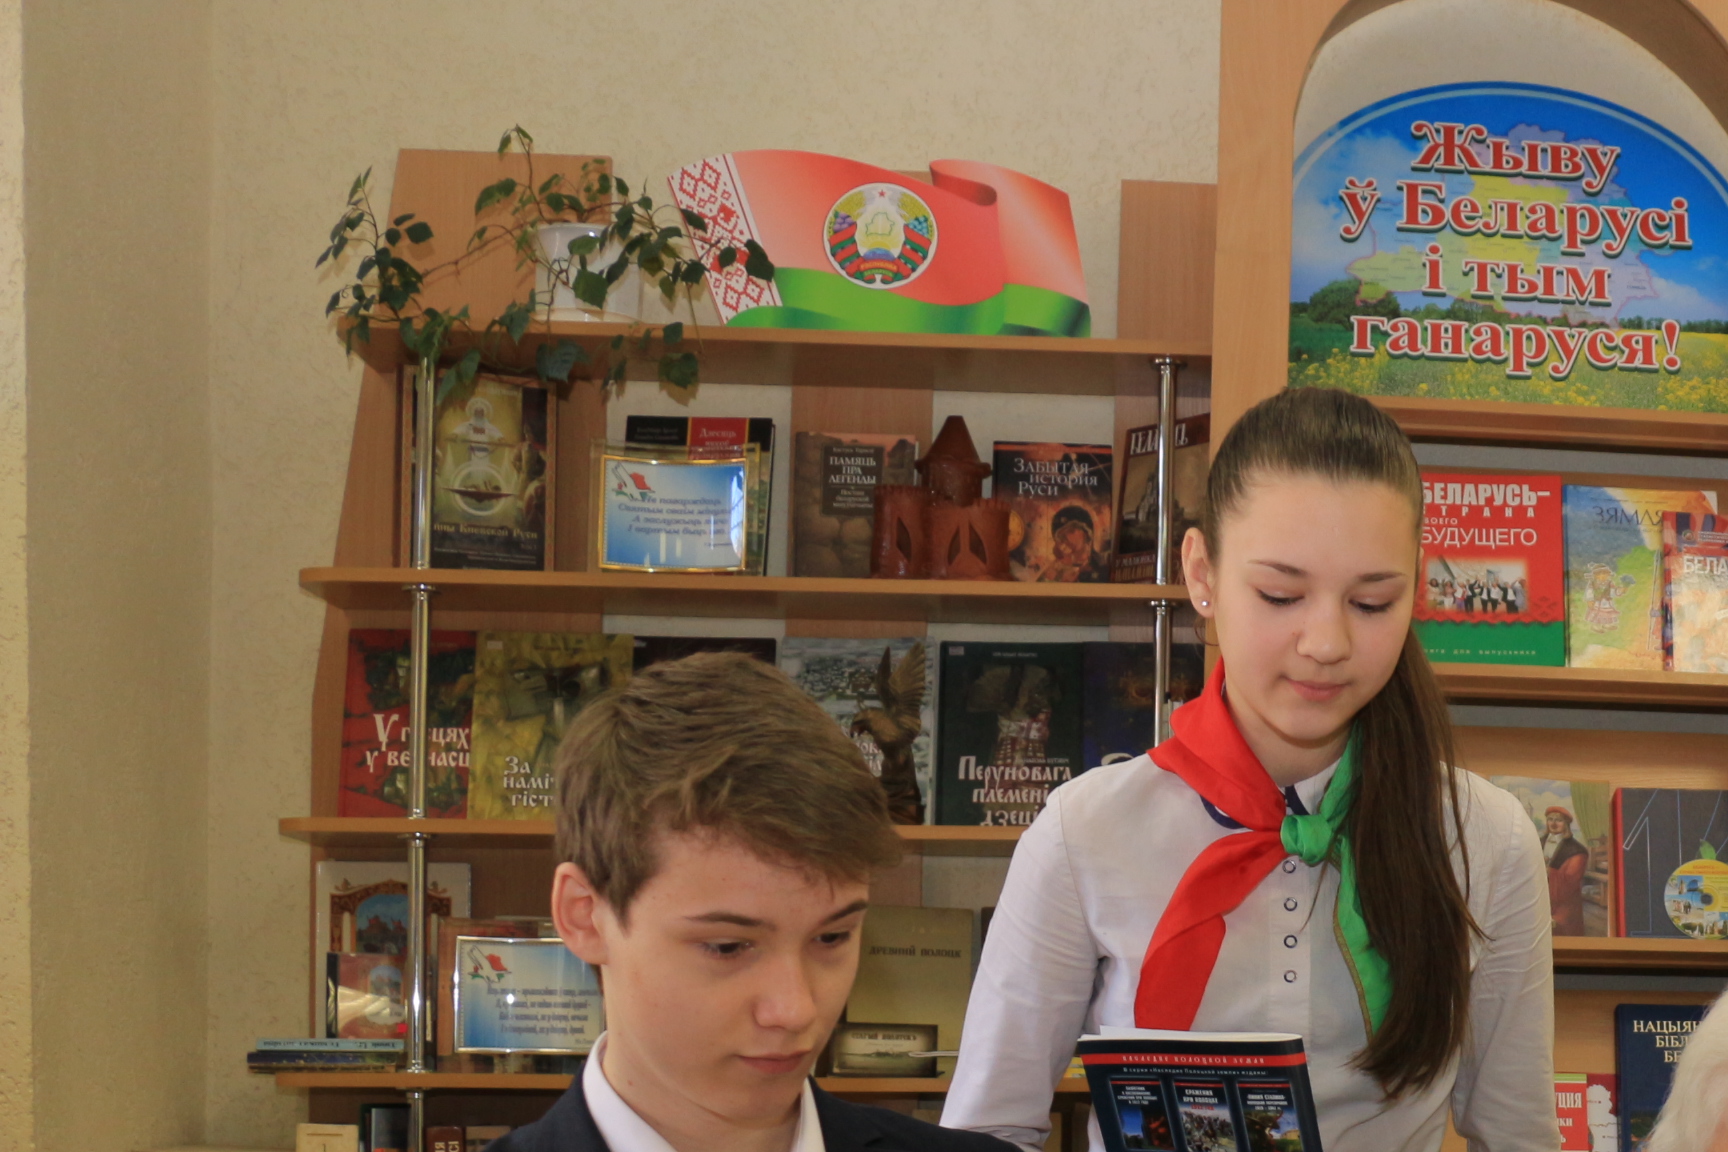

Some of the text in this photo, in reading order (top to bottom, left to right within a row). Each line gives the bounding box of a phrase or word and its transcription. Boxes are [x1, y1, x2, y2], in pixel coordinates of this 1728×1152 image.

[1410, 121, 1620, 194] Жыву
[1339, 177, 1692, 257] ў Беларусі
[1422, 243, 1612, 306] і тым
[1350, 314, 1681, 379] ганаруся!
[1130, 423, 1188, 455] БЕЛАСЬ
[829, 456, 876, 467] ПАМЯЦЬ
[842, 466, 862, 475] ПРА
[829, 474, 876, 485] ЛЕГЕНДЫ
[1422, 527, 1538, 550] БУДУЩЕГО
[503, 755, 531, 776] За
[869, 945, 961, 958] ДРЕВНИЙ ПОЛОЦК
